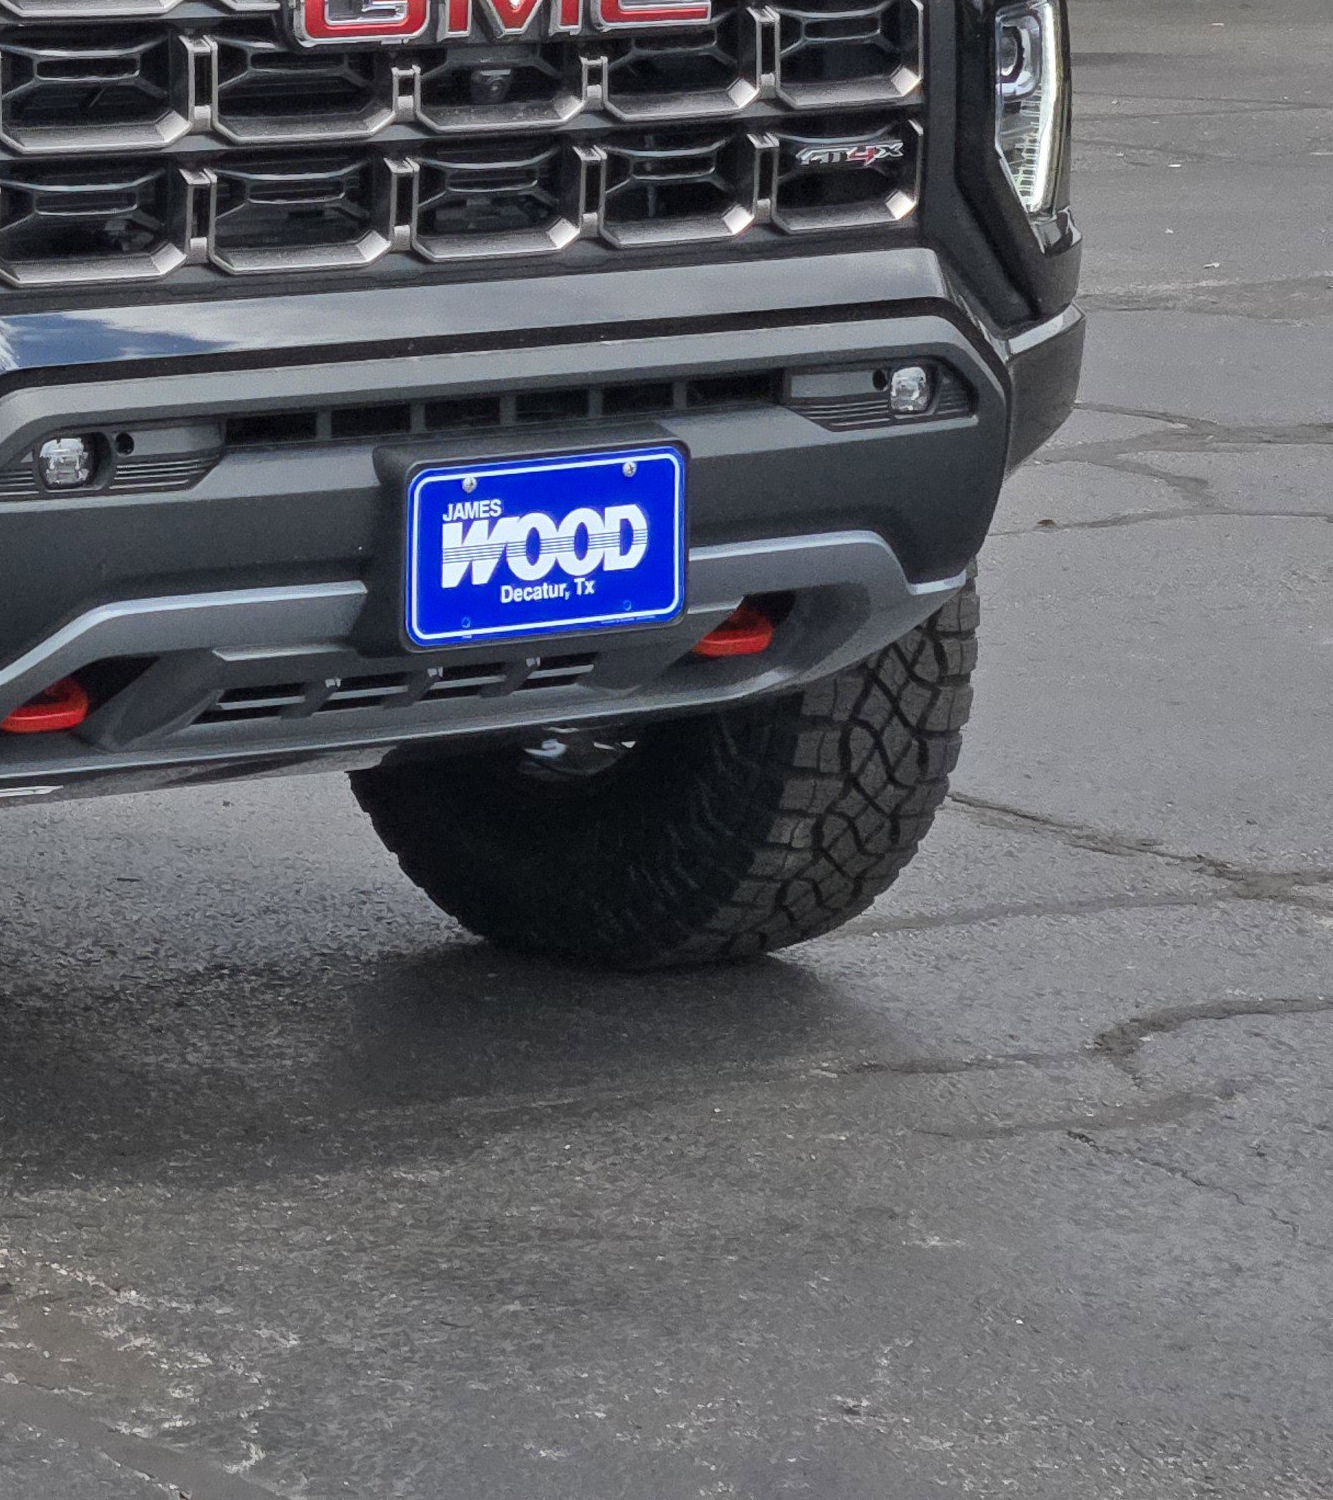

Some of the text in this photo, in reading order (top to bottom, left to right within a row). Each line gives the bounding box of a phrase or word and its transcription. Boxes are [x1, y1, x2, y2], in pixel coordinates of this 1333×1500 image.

[795, 141, 904, 167] AT4X
[442, 499, 502, 521] JAMES
[441, 504, 648, 588] WOOD
[501, 577, 595, 603] Decatur, Tx
